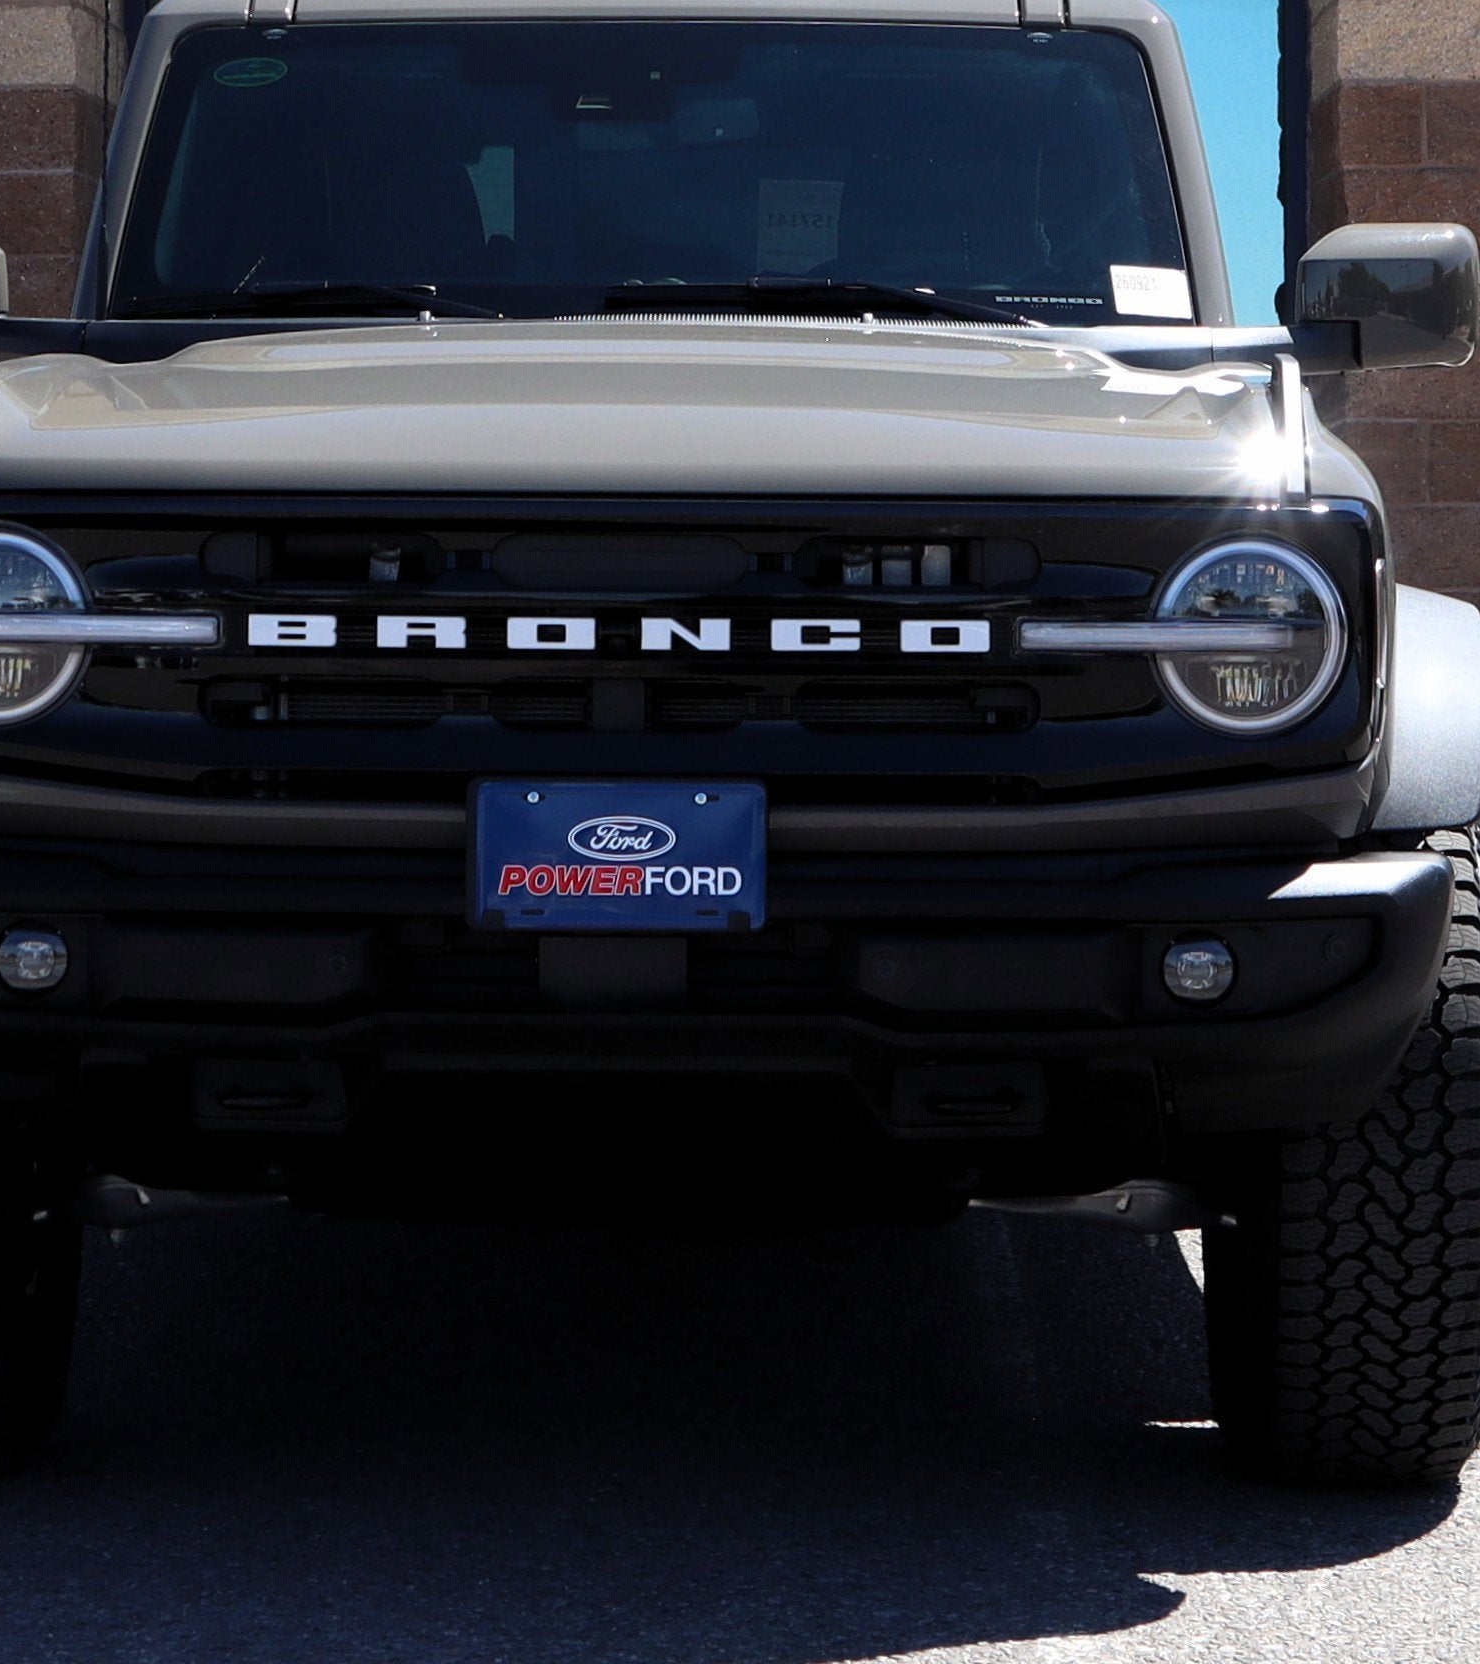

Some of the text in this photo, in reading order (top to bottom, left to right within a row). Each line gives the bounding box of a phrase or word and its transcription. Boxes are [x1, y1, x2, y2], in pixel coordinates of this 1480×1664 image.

[995, 295, 1104, 305] BRONCO
[247, 613, 991, 653] BRONCO
[589, 823, 654, 851] Ford
[498, 864, 743, 896] POWERFORD
